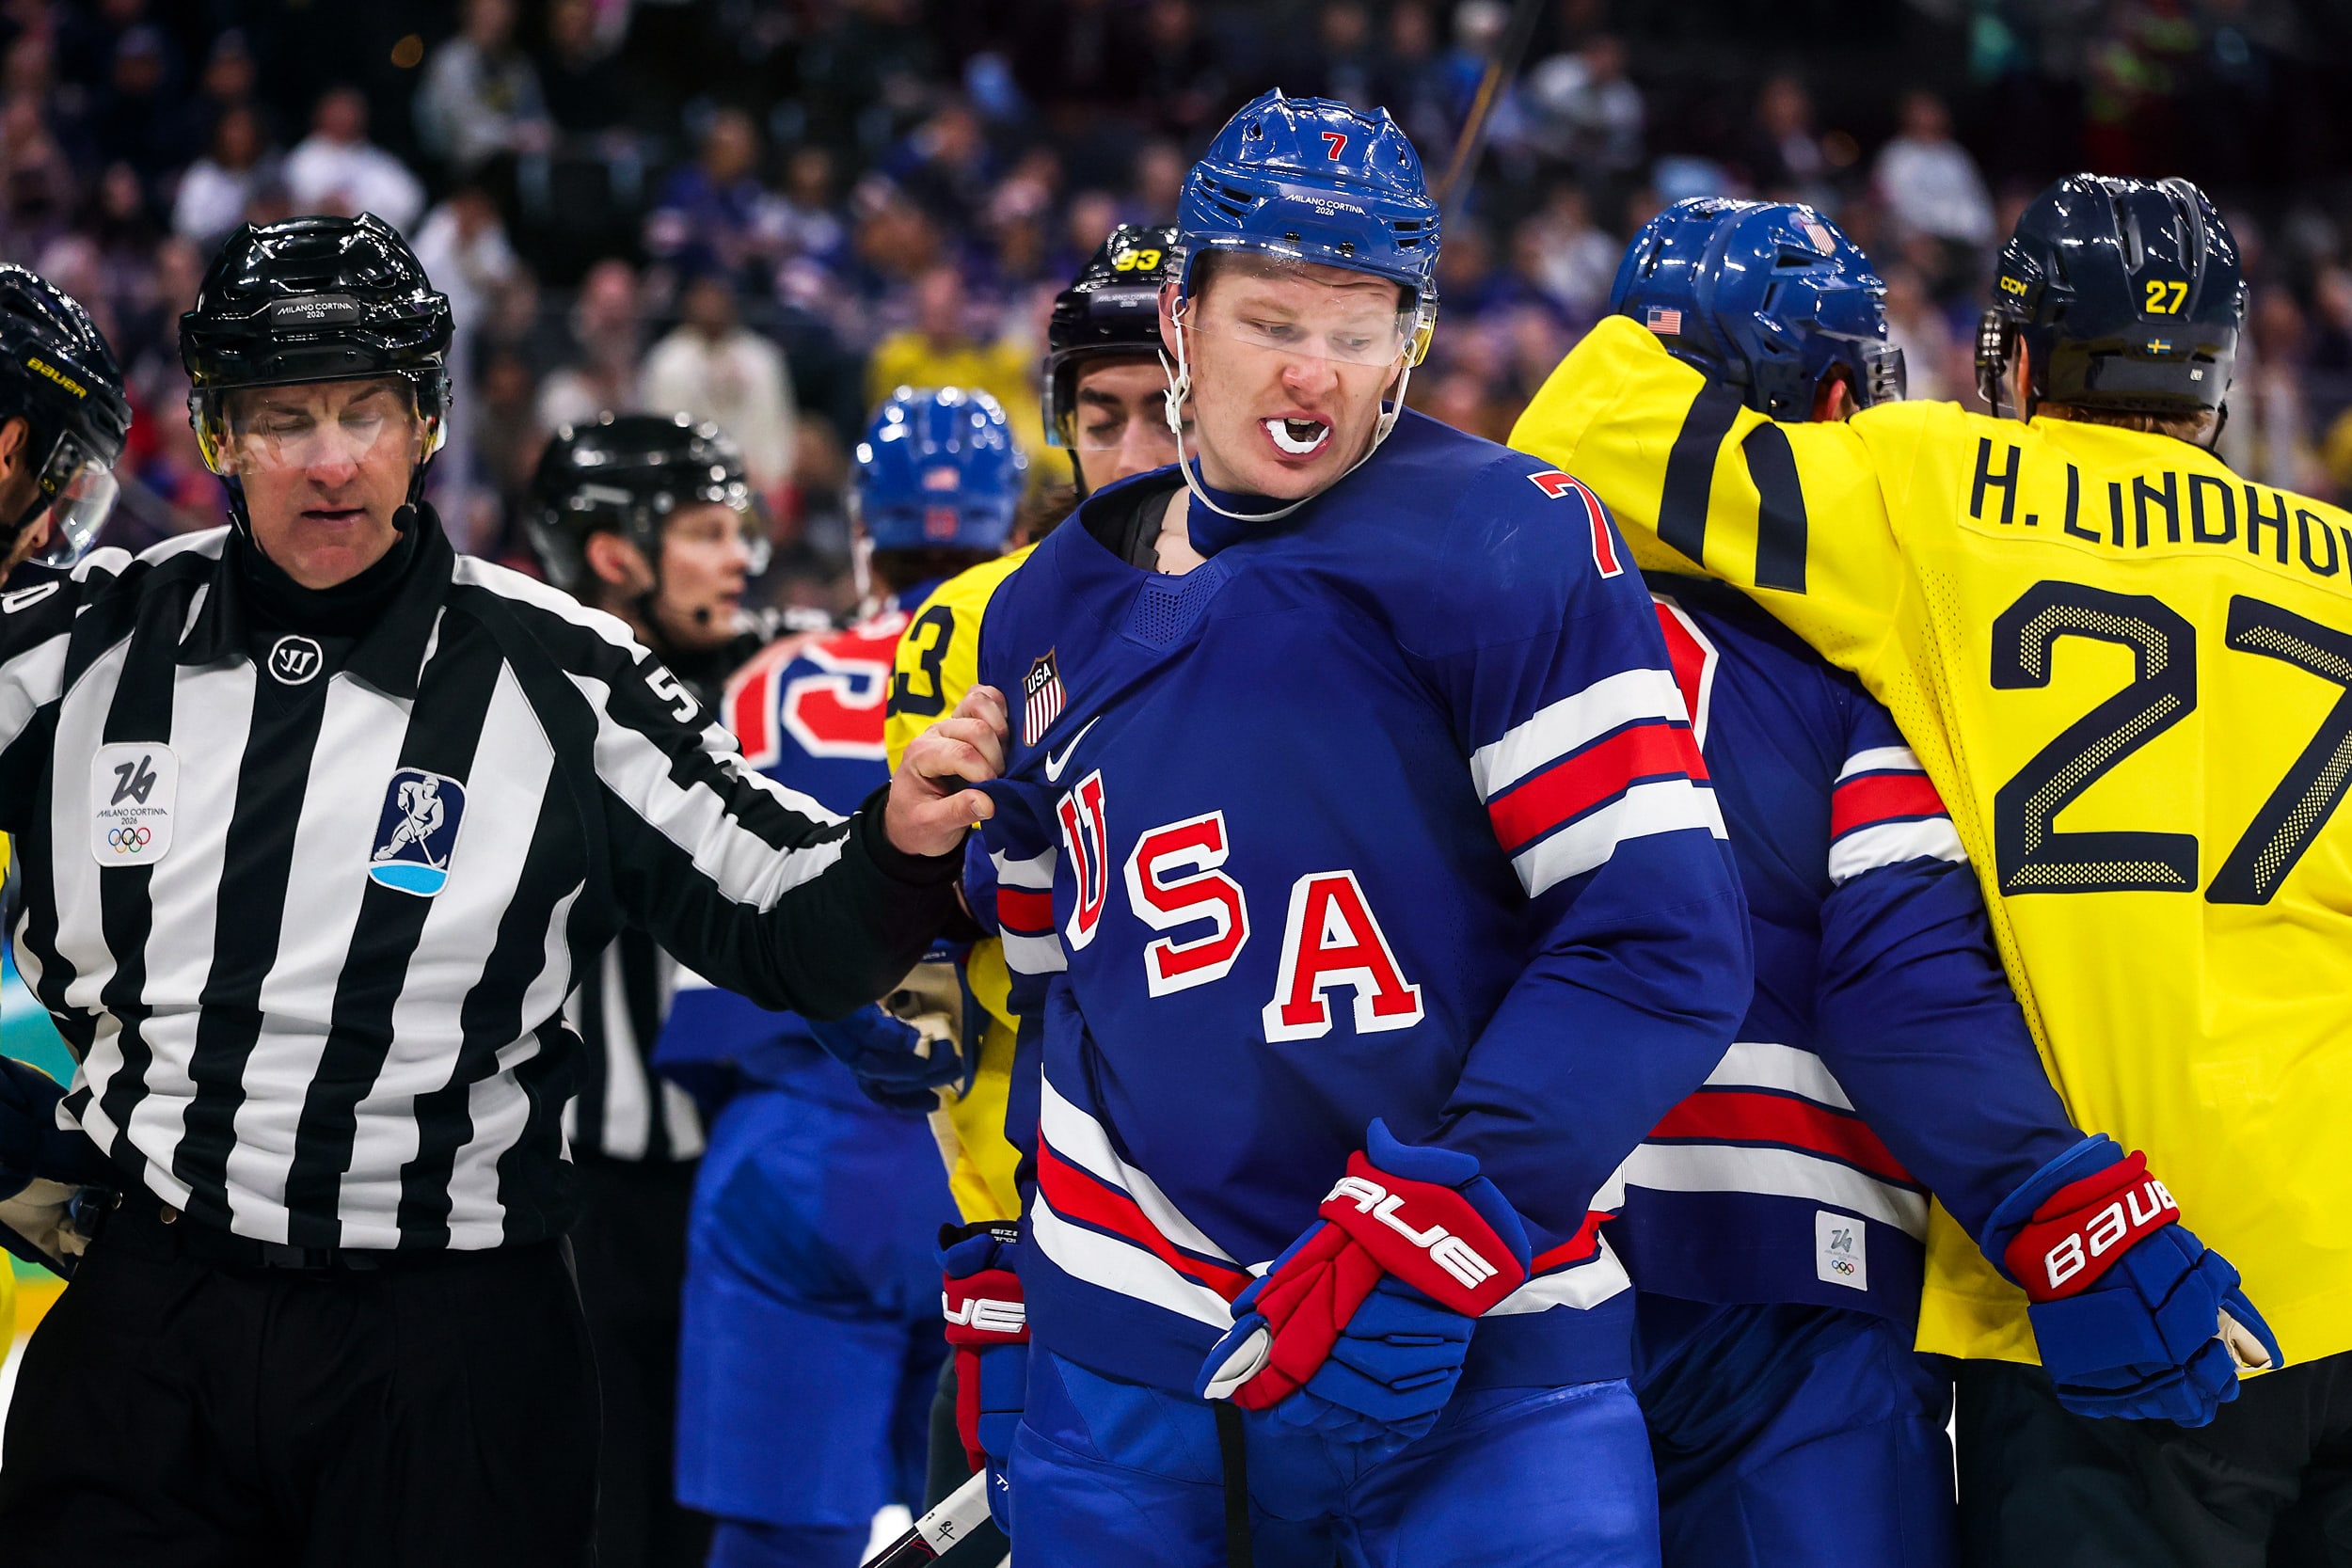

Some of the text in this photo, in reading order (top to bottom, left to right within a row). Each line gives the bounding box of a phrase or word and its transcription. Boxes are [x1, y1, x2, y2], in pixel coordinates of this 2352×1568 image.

[1321, 131, 1348, 162] 7
[1285, 194, 1366, 215] MILANO CORTINA
[1315, 207, 1335, 216] 2026
[1115, 249, 1162, 272] 93
[2000, 276, 2028, 297] CCM
[2146, 280, 2188, 314] 27
[277, 302, 354, 316] MILANO CORTINA
[307, 310, 326, 319] 2026
[1969, 436, 2352, 587] H. LINDHO
[1526, 469, 1625, 579] 7
[1026, 662, 1053, 695] USA
[1989, 579, 2352, 907] 27
[96, 807, 168, 819] MILANO CORTINA
[120, 816, 138, 826] 2026
[1056, 768, 1426, 1044] USA
